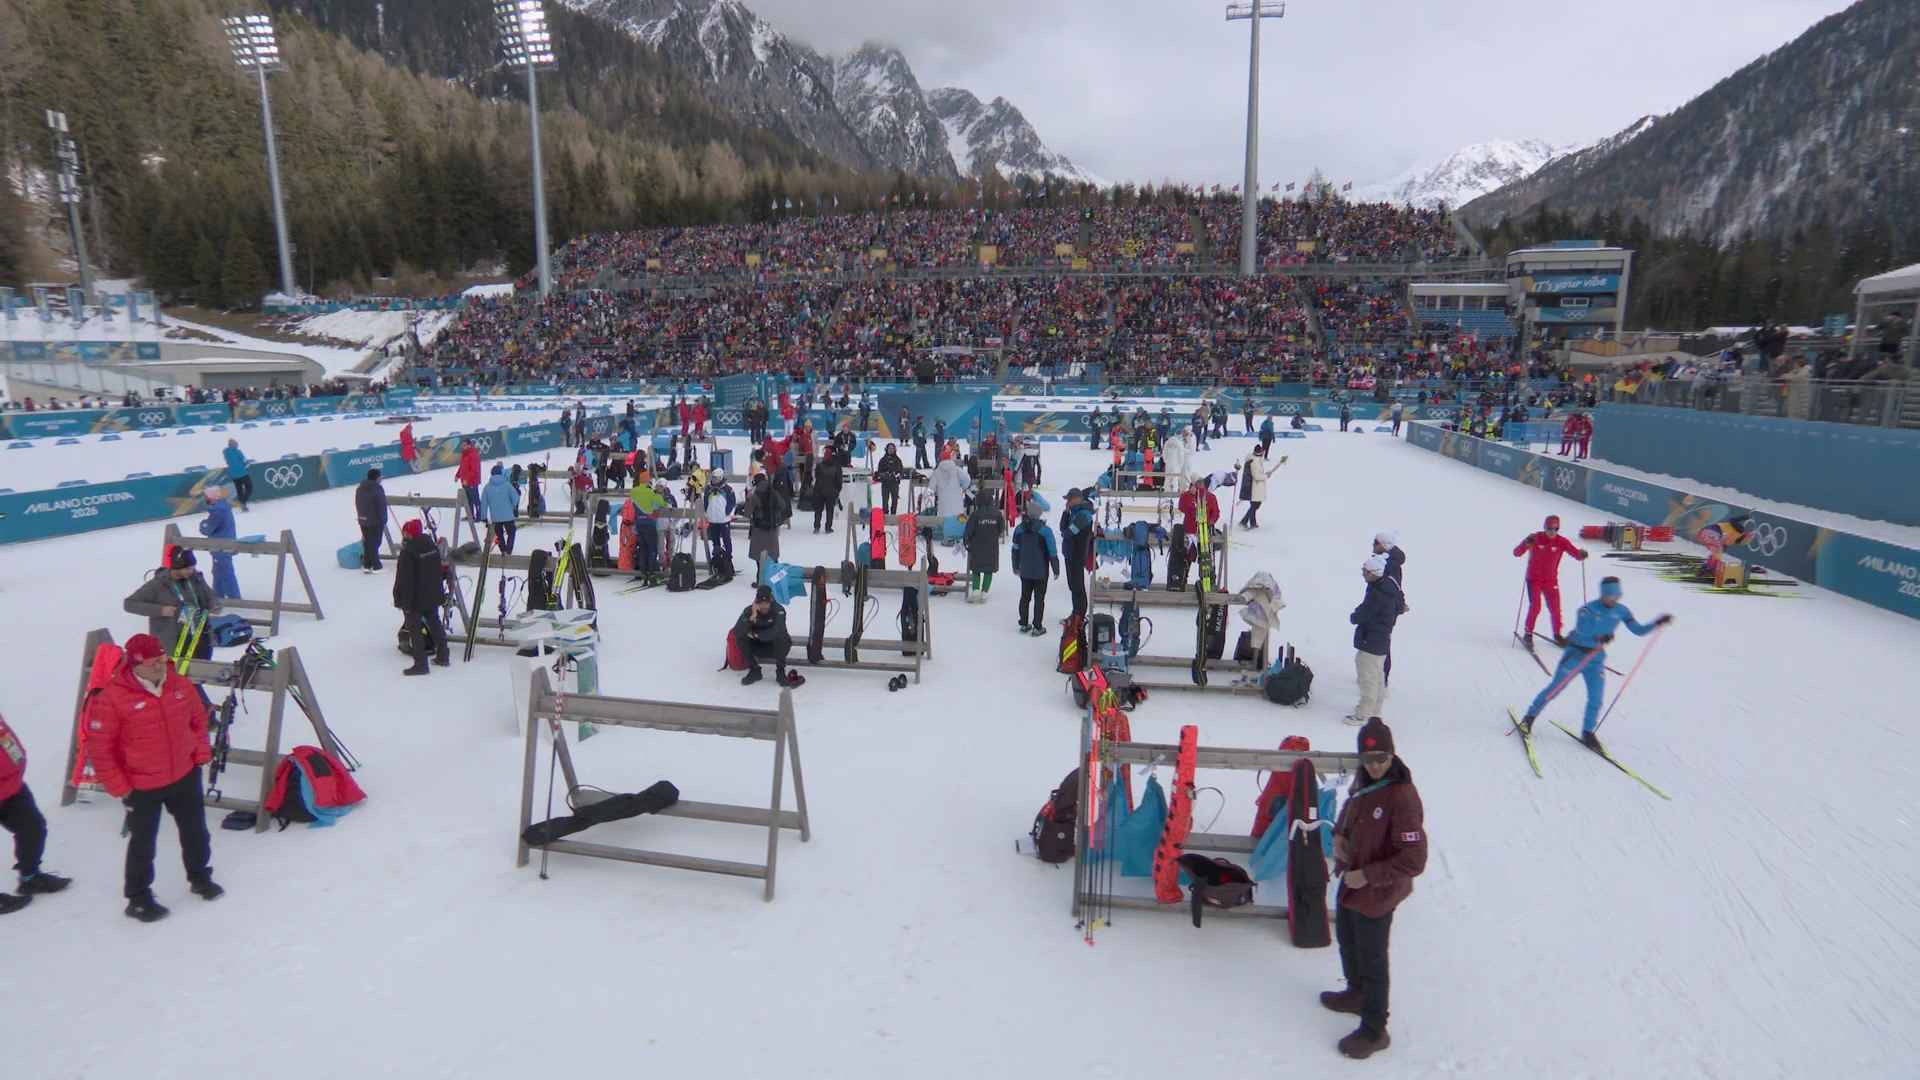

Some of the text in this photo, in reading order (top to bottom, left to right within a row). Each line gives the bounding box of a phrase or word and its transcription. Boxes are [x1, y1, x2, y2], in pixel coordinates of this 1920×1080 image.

[1552, 279, 1582, 292] your
[1583, 275, 1608, 287] vibe
[23, 491, 136, 515] MILANO CORTINA
[70, 506, 98, 519] 2026
[1857, 554, 1917, 580] MILANO
